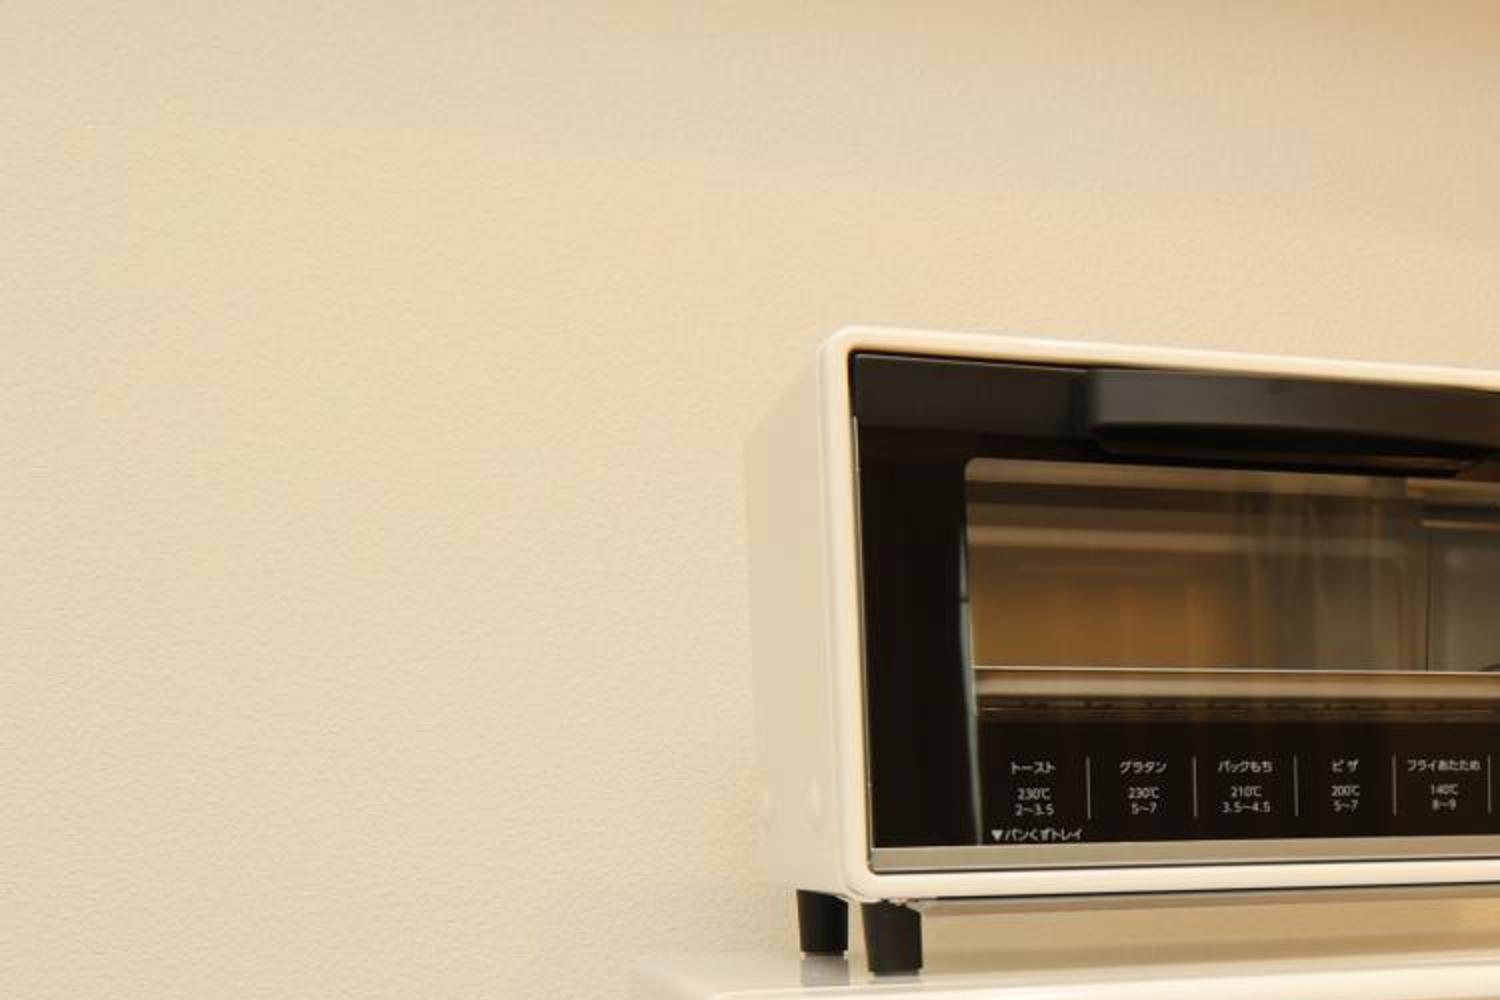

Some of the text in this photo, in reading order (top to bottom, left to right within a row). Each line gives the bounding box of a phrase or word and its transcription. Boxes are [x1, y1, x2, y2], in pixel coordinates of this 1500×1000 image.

[1011, 761, 1056, 774] トースト
[1119, 760, 1167, 774] グラタン
[1217, 760, 1273, 773] パックもち
[1407, 759, 1481, 771] フライあたため
[1004, 827, 1083, 841] パンくずトレイ
